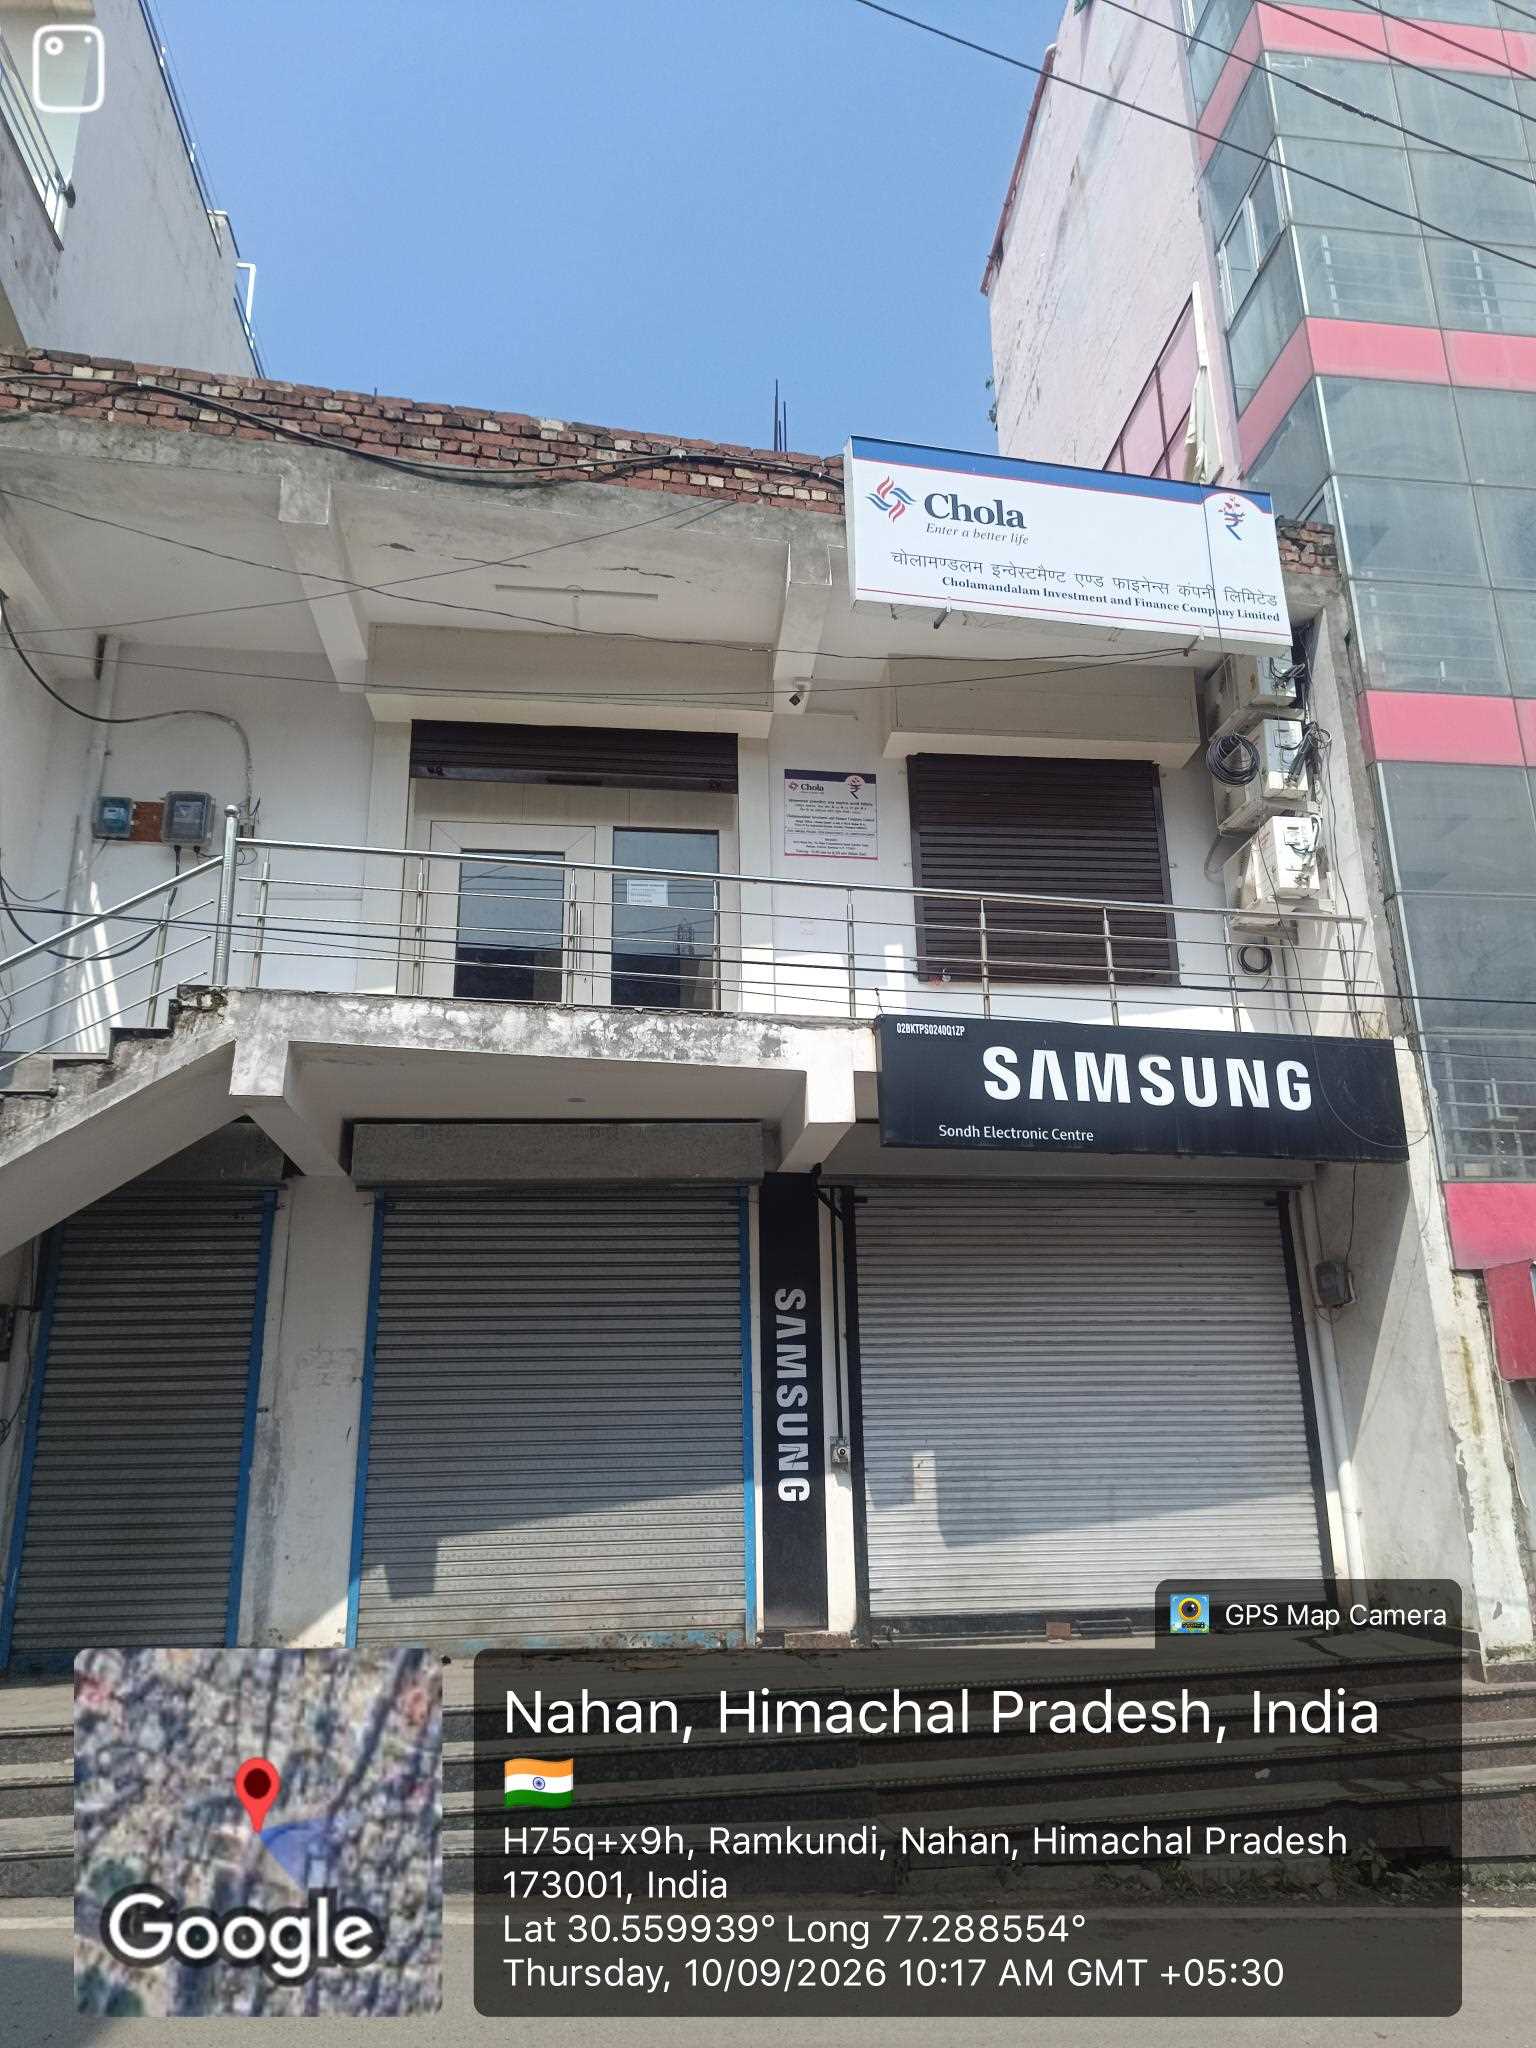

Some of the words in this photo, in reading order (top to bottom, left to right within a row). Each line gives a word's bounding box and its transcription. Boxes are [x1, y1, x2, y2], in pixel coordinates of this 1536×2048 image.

[924, 493, 1028, 529] Chola
[926, 522, 958, 536] Enter
[962, 530, 969, 538] a
[973, 528, 1007, 542] better
[1010, 533, 1029, 546] life
[890, 548, 983, 574] चोलामण्डलम
[1072, 573, 1104, 588] एण्ड
[1224, 585, 1278, 607] लिमिटेड
[942, 576, 1040, 596] Cholamandalam
[1043, 587, 1107, 605] Investment
[1111, 593, 1131, 606] and
[1135, 597, 1179, 611] Finance
[1182, 603, 1234, 619] Company
[1237, 609, 1280, 622] Limited
[800, 783, 824, 792] Chola
[983, 1046, 1312, 1111] SAMSUNG
[938, 1124, 980, 1137] Sondh
[983, 1126, 1049, 1140] Electronic
[1051, 1128, 1094, 1141] Centre
[775, 1288, 810, 1502] SAMSUNG
